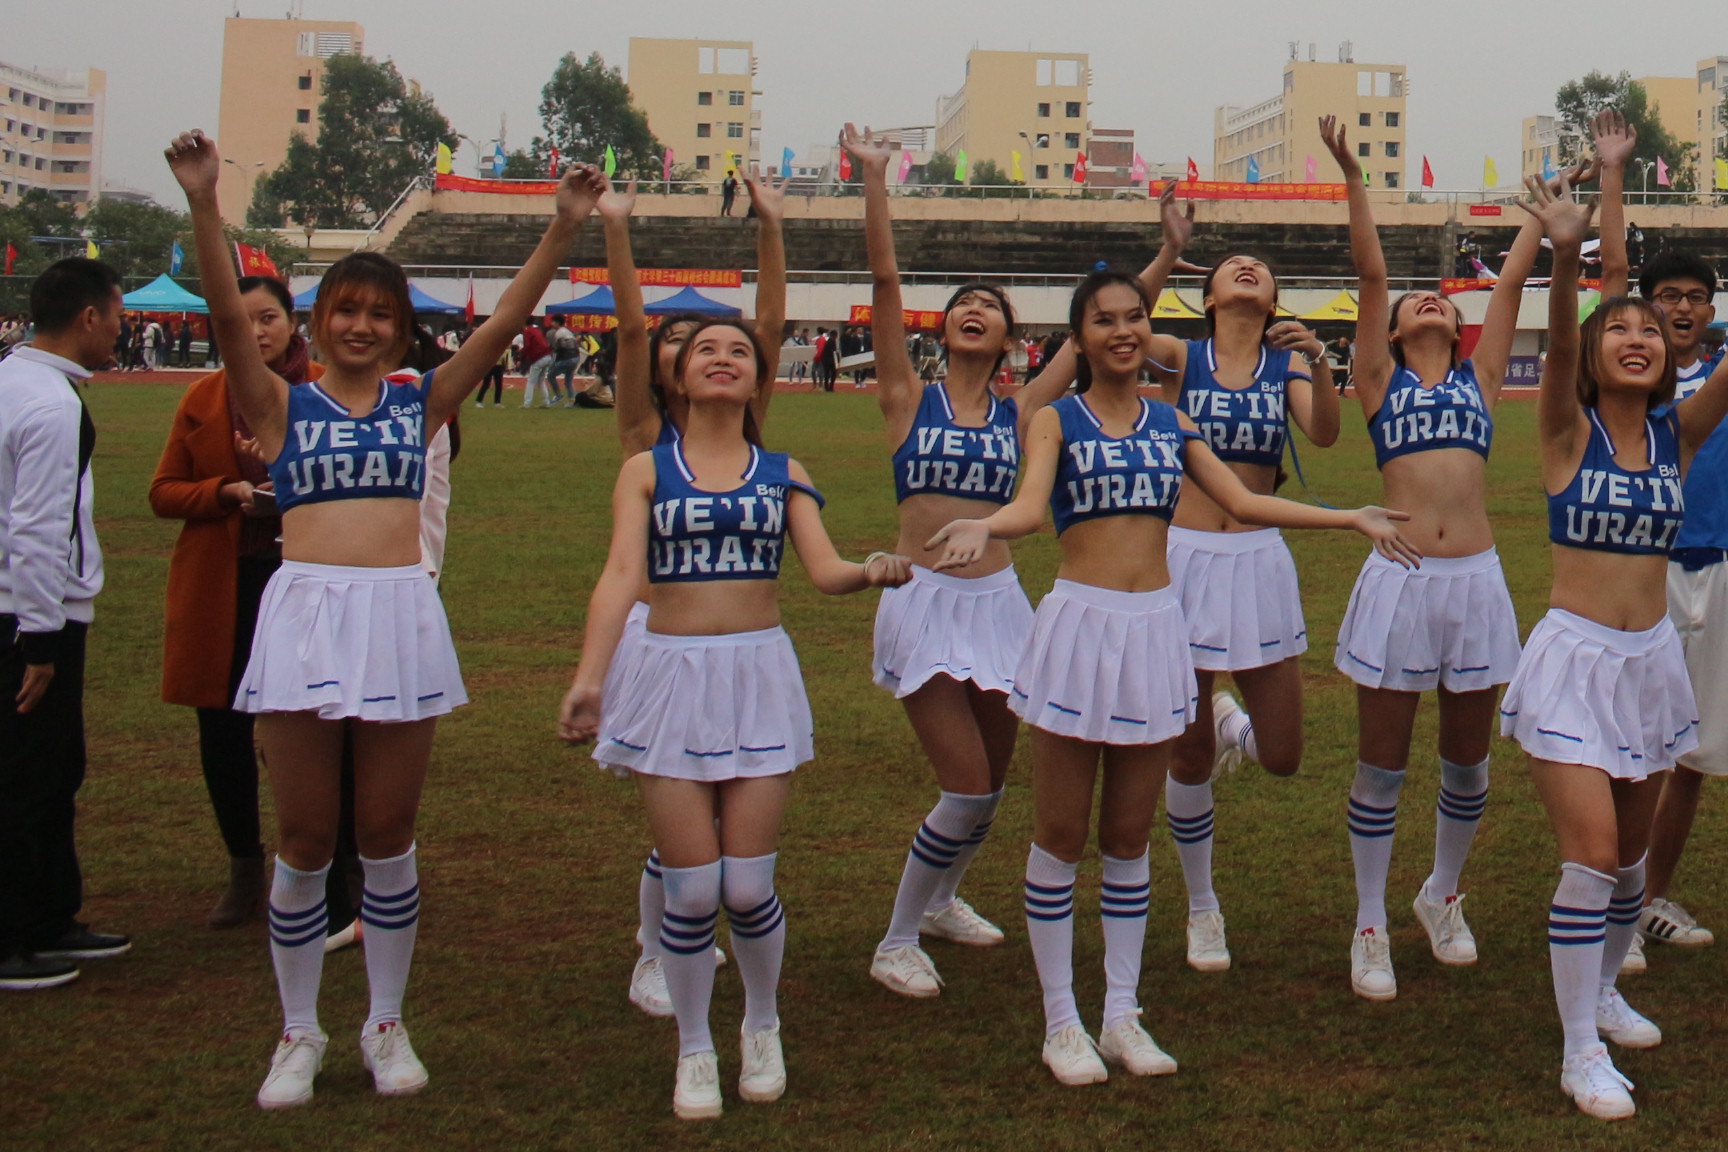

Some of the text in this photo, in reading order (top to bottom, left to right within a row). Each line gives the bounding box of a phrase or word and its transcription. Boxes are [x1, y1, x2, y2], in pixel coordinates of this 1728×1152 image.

[1505, 363, 1540, 377] 省足
[389, 402, 422, 417] Bell
[1187, 389, 1284, 421] VE'IN
[294, 415, 423, 453] VE'IN
[917, 427, 1017, 465] VE'IN
[1194, 422, 1285, 454] RAIT
[1382, 409, 1489, 449] URAIT
[288, 451, 423, 495] URAIT
[1069, 439, 1183, 473] VE'IN
[1658, 463, 1679, 477] Bel
[1581, 469, 1685, 512] VE'IN
[653, 497, 783, 536] VE'IN
